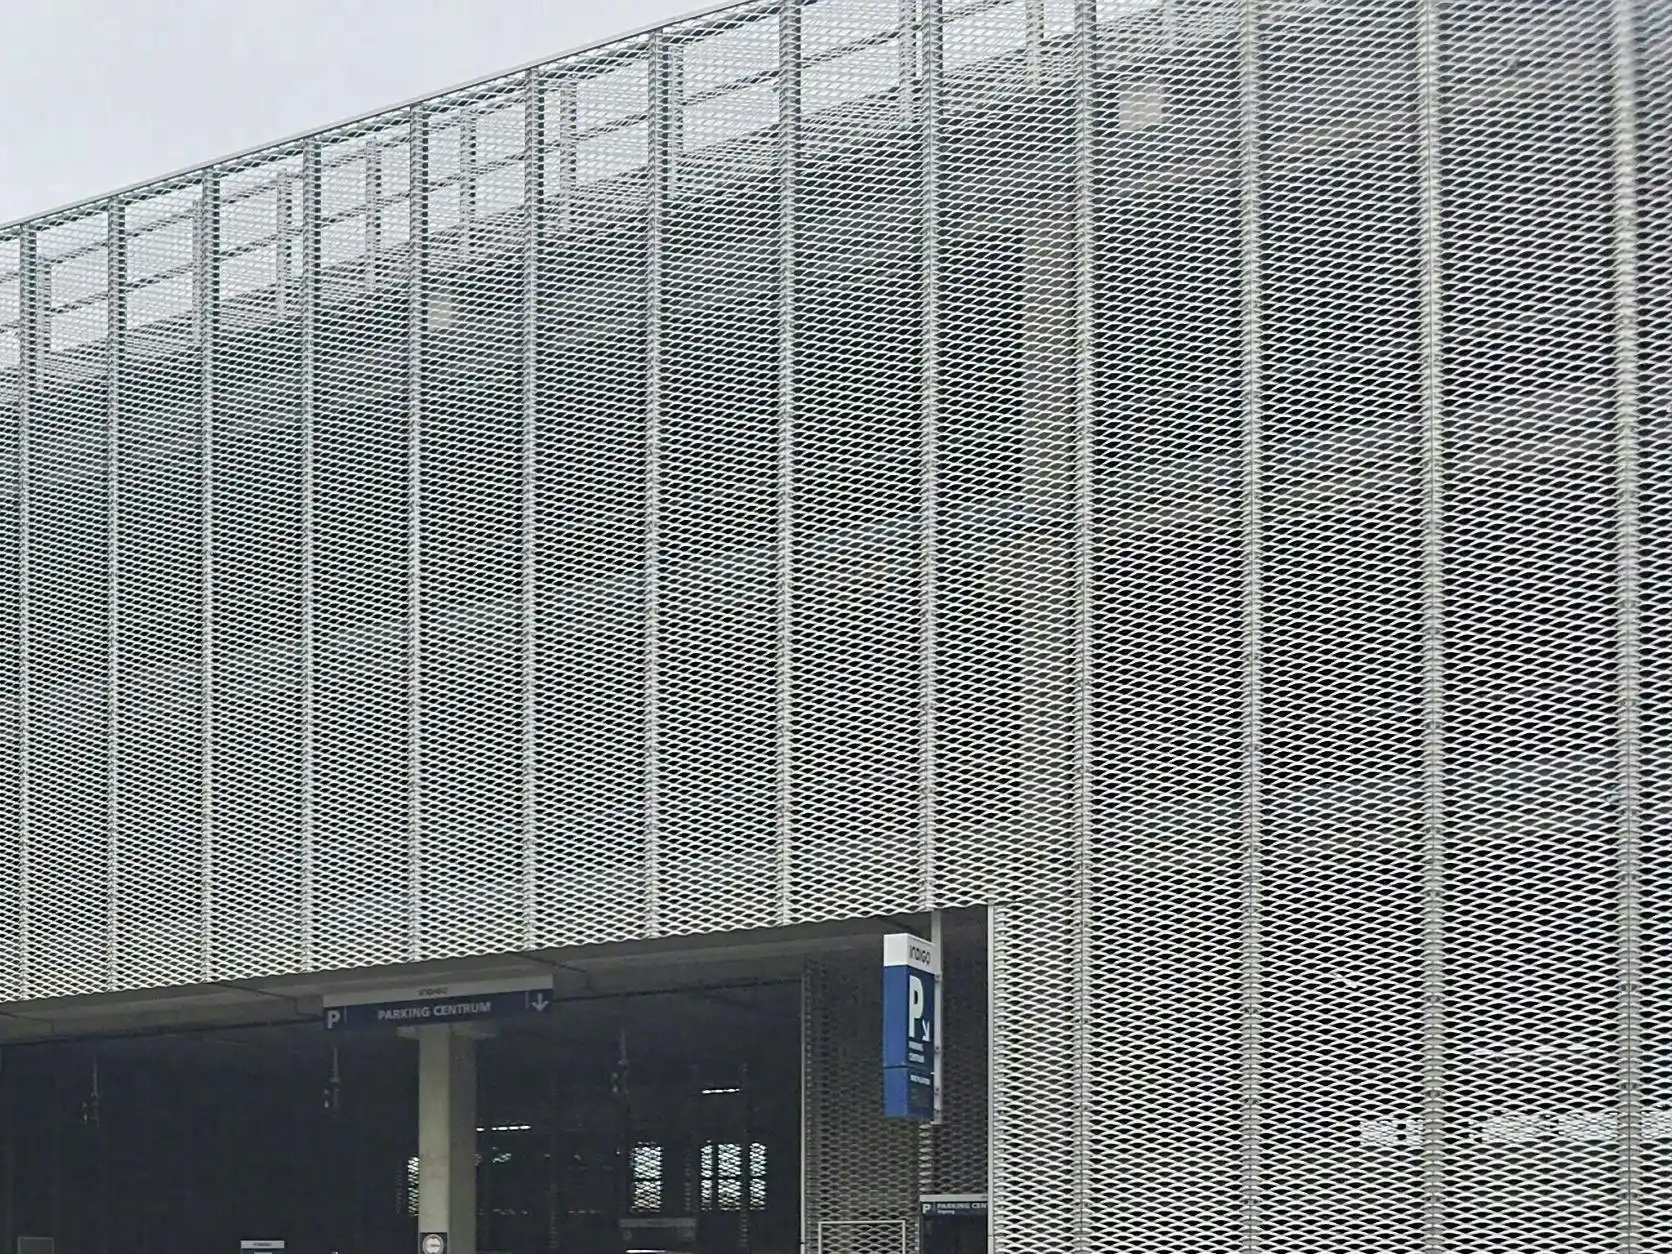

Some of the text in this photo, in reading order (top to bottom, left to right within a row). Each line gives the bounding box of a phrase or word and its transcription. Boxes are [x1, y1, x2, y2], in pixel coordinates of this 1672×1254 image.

[328, 1002, 491, 1029] P PARKING CENTRUM
[909, 974, 924, 1038] P
[922, 1203, 932, 1214] P
